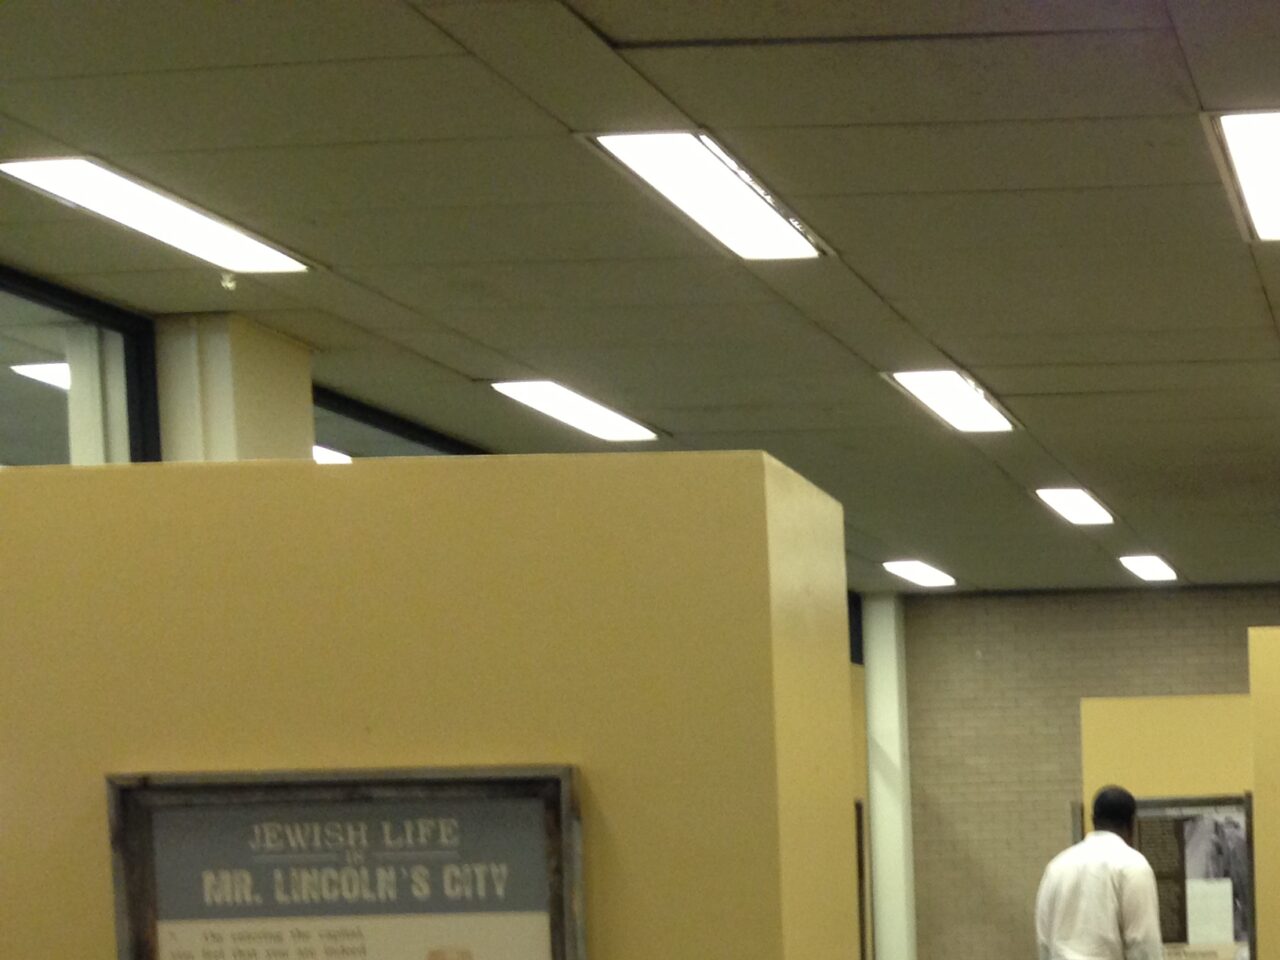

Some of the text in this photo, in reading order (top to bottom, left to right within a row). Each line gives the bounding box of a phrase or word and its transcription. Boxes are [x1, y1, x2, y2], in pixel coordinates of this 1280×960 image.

[248, 818, 460, 851] JEWISH LIFE
[202, 861, 509, 906] MR. LINCOLN'S CITY
